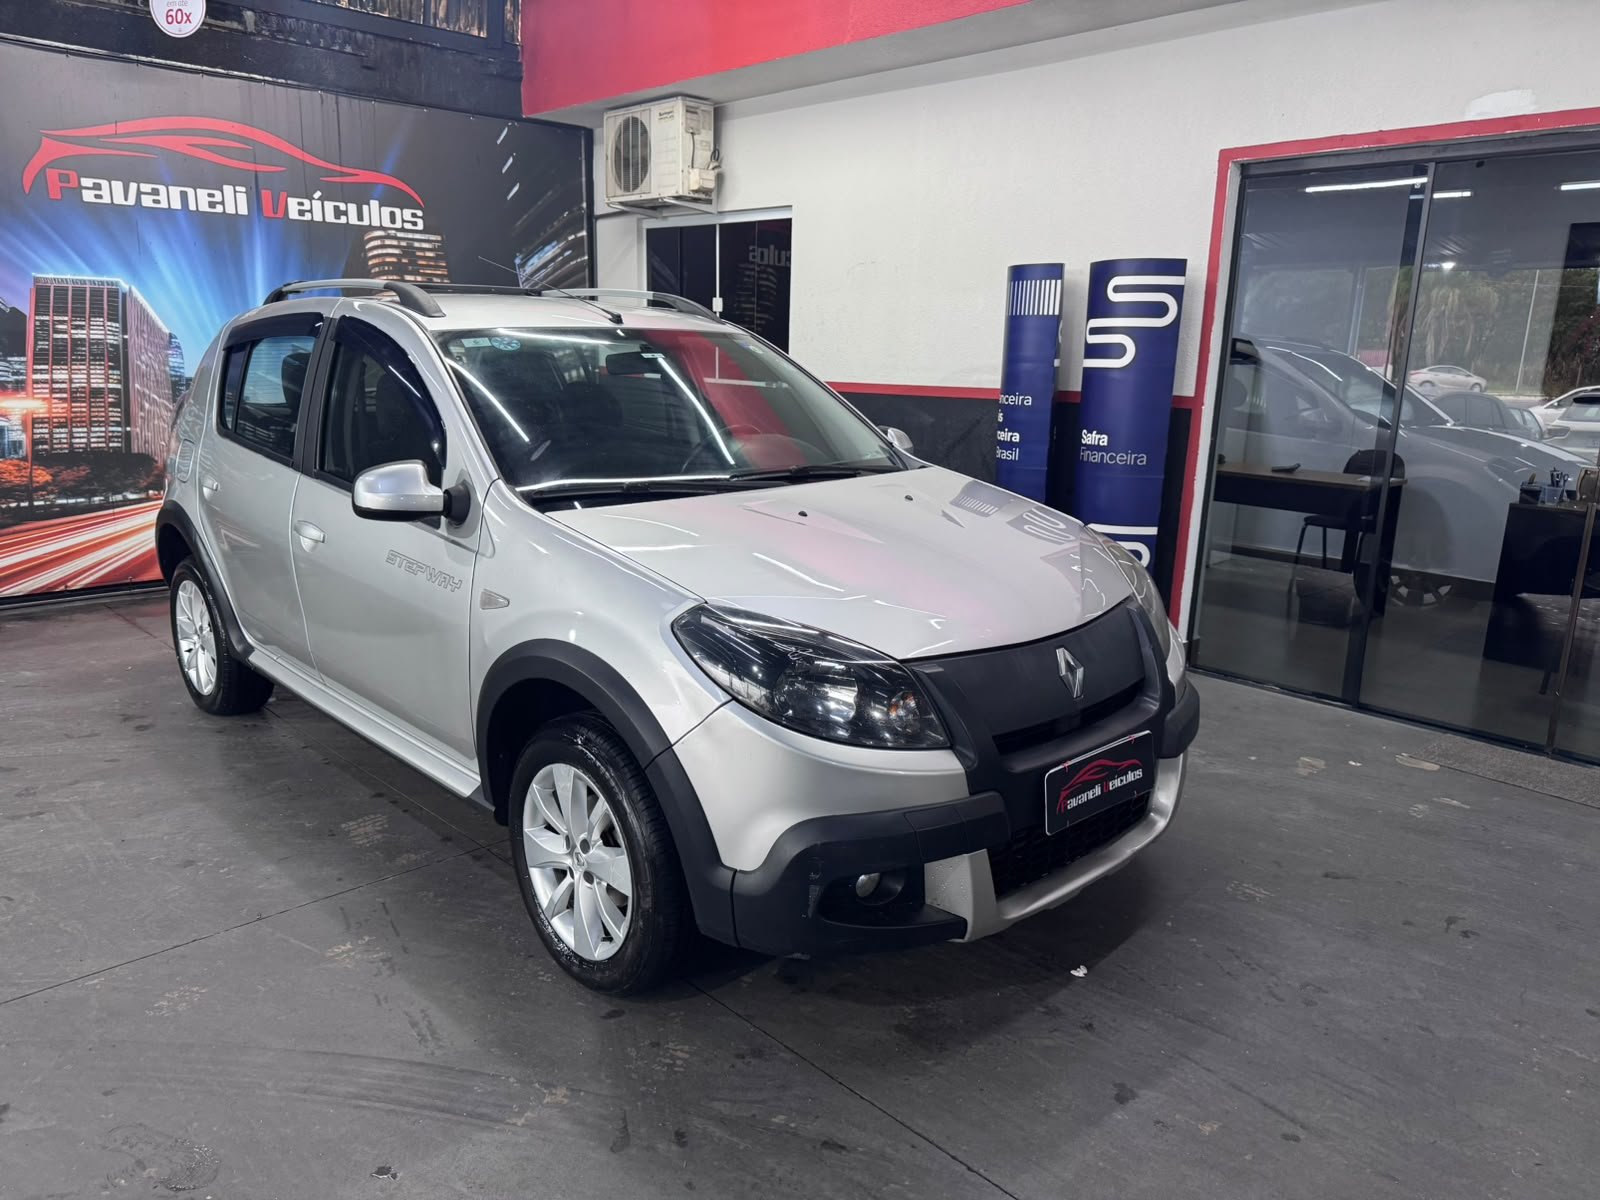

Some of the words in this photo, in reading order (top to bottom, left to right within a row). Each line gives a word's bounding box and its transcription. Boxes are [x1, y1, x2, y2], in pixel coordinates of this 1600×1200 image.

[165, 8, 192, 25] 60x
[45, 167, 249, 216] Pavaneli
[260, 188, 424, 231] Veículos
[1081, 429, 1108, 446] Safra
[1080, 446, 1147, 465] Financeira
[385, 549, 463, 592] STEPWAY
[1061, 783, 1102, 813] Pavaneli
[1103, 769, 1143, 793] Veículos
